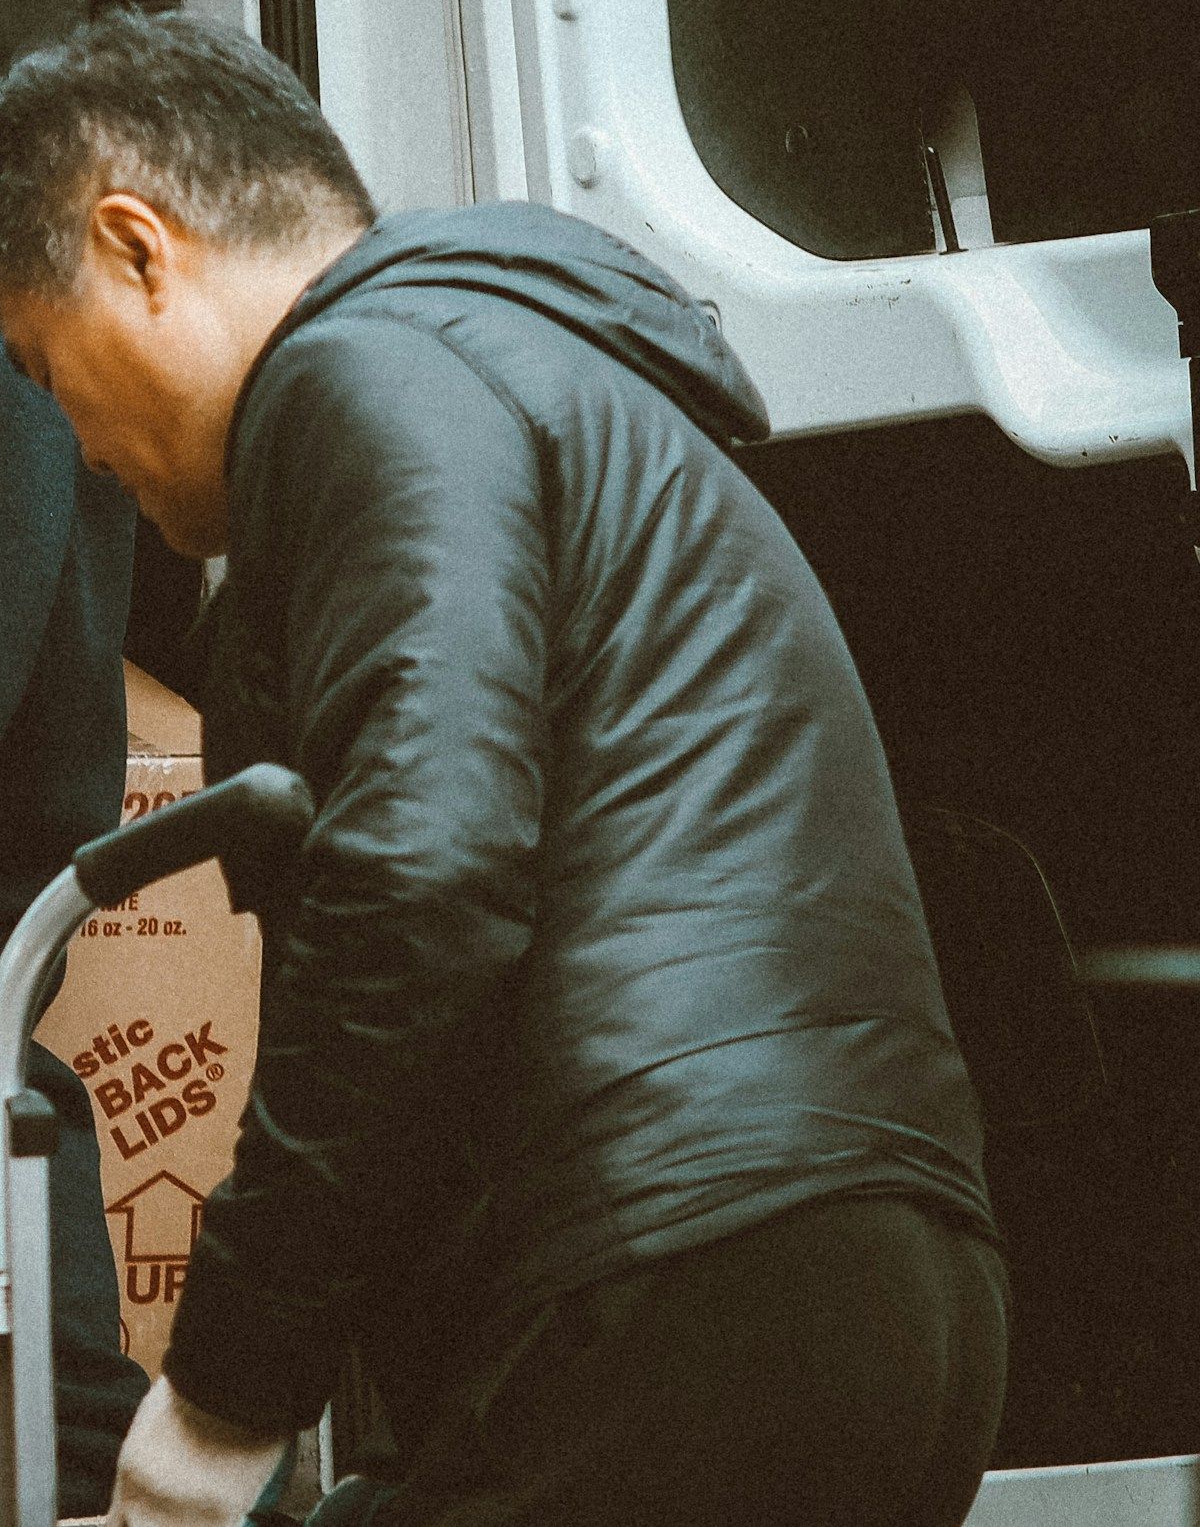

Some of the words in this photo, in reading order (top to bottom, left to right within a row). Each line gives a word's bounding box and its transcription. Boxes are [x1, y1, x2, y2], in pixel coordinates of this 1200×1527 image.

[103, 922, 122, 937] oz
[137, 917, 159, 936] 20
[163, 920, 187, 936] oz.
[94, 1021, 228, 1120] BACK
